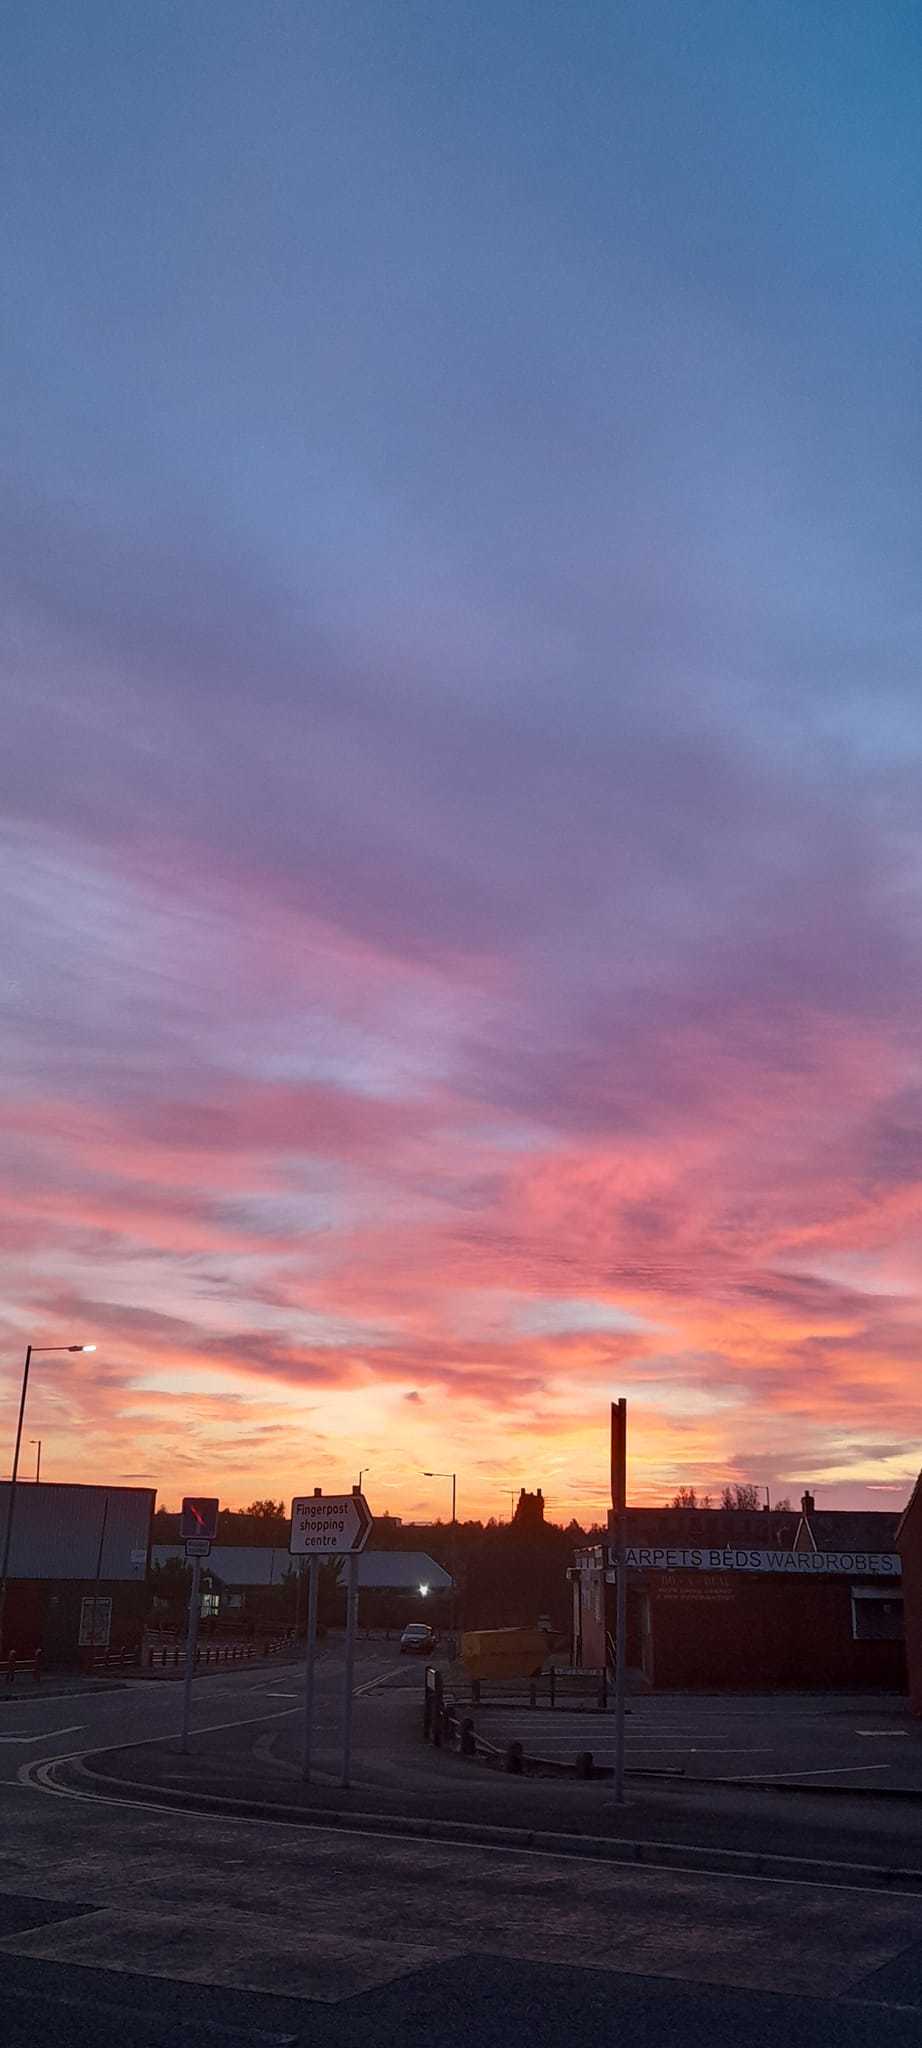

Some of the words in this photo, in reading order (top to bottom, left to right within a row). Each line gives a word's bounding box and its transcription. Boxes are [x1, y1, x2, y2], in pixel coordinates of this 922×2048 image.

[296, 1503, 348, 1517] Fingerpost
[300, 1519, 344, 1532] shopping
[304, 1536, 337, 1546] centre
[709, 1550, 762, 1568] BEDS
[766, 1553, 893, 1572] WARDROBES
